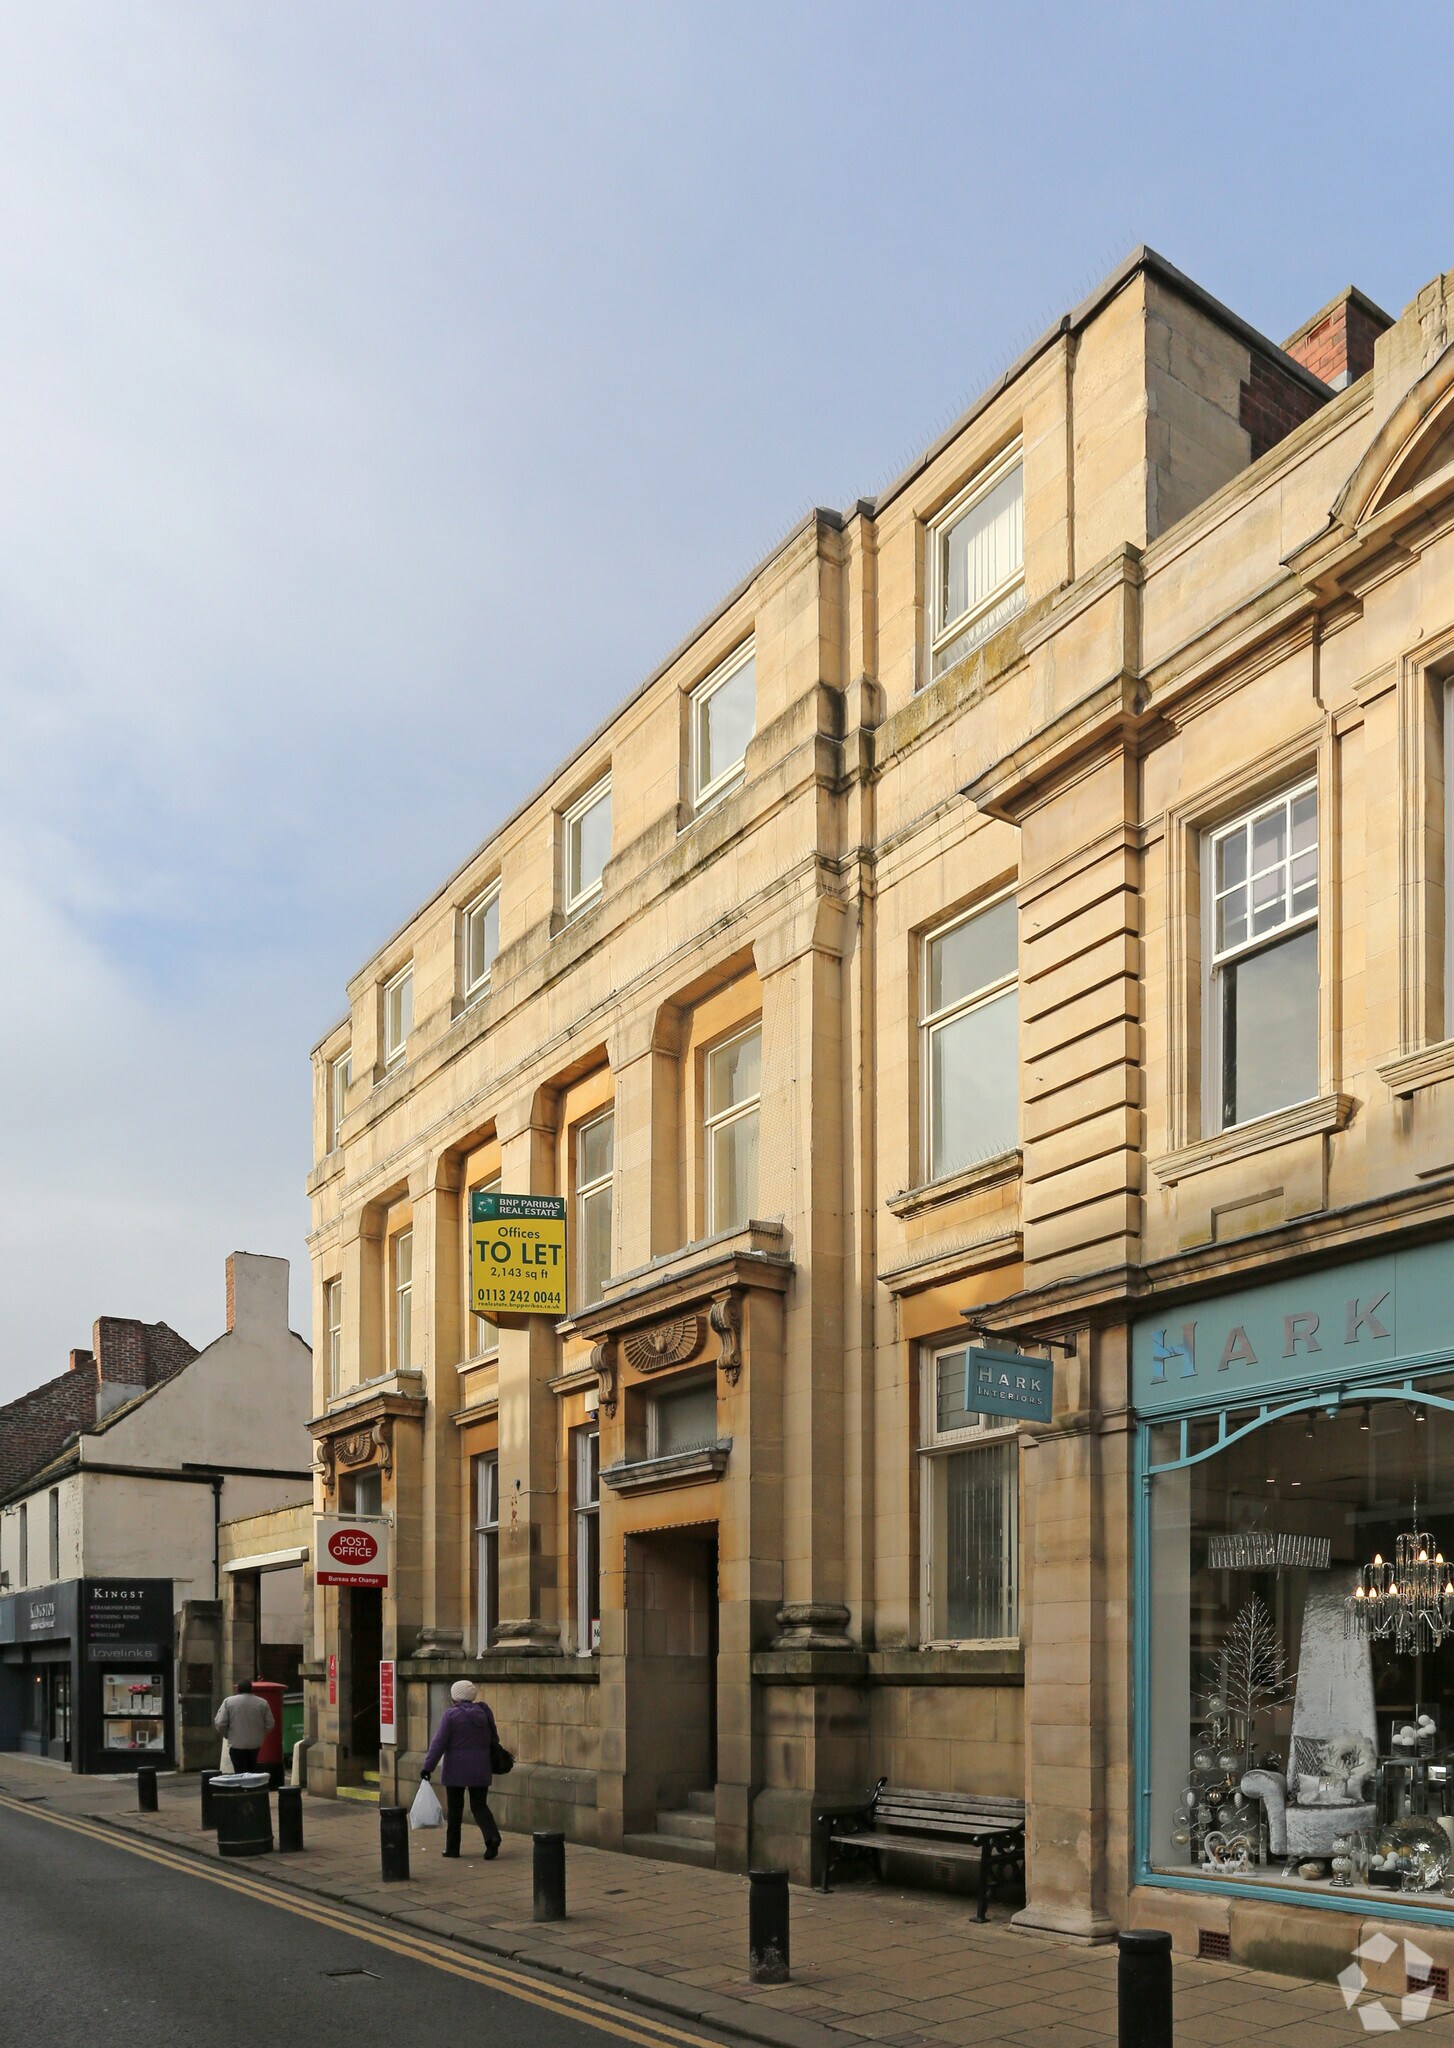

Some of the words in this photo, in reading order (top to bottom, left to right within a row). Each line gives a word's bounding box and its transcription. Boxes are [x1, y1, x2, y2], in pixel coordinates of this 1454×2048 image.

[499, 1198, 519, 1206] BNP
[521, 1200, 560, 1209] PARIBAS
[499, 1206, 523, 1215] REAL
[525, 1208, 558, 1217] ESTATE
[497, 1226, 540, 1239] Offices
[476, 1240, 511, 1263] TO
[522, 1243, 562, 1265] LET
[490, 1267, 522, 1278] 2,143
[525, 1270, 538, 1280] sq
[541, 1269, 548, 1279] ft
[478, 1288, 506, 1302] 0113
[510, 1290, 530, 1303] 242
[533, 1291, 561, 1304] 0044
[478, 1302, 560, 1310] realestate.bnpparibas.co.uk
[1150, 1291, 1391, 1386] HARK
[978, 1366, 1043, 1392] HARK
[977, 1386, 1043, 1405] INTERIORS
[339, 1536, 368, 1546] POST
[333, 1546, 372, 1557] OFFICE
[93, 1588, 145, 1599] KINGST
[93, 1648, 153, 1658] Lovelinks
